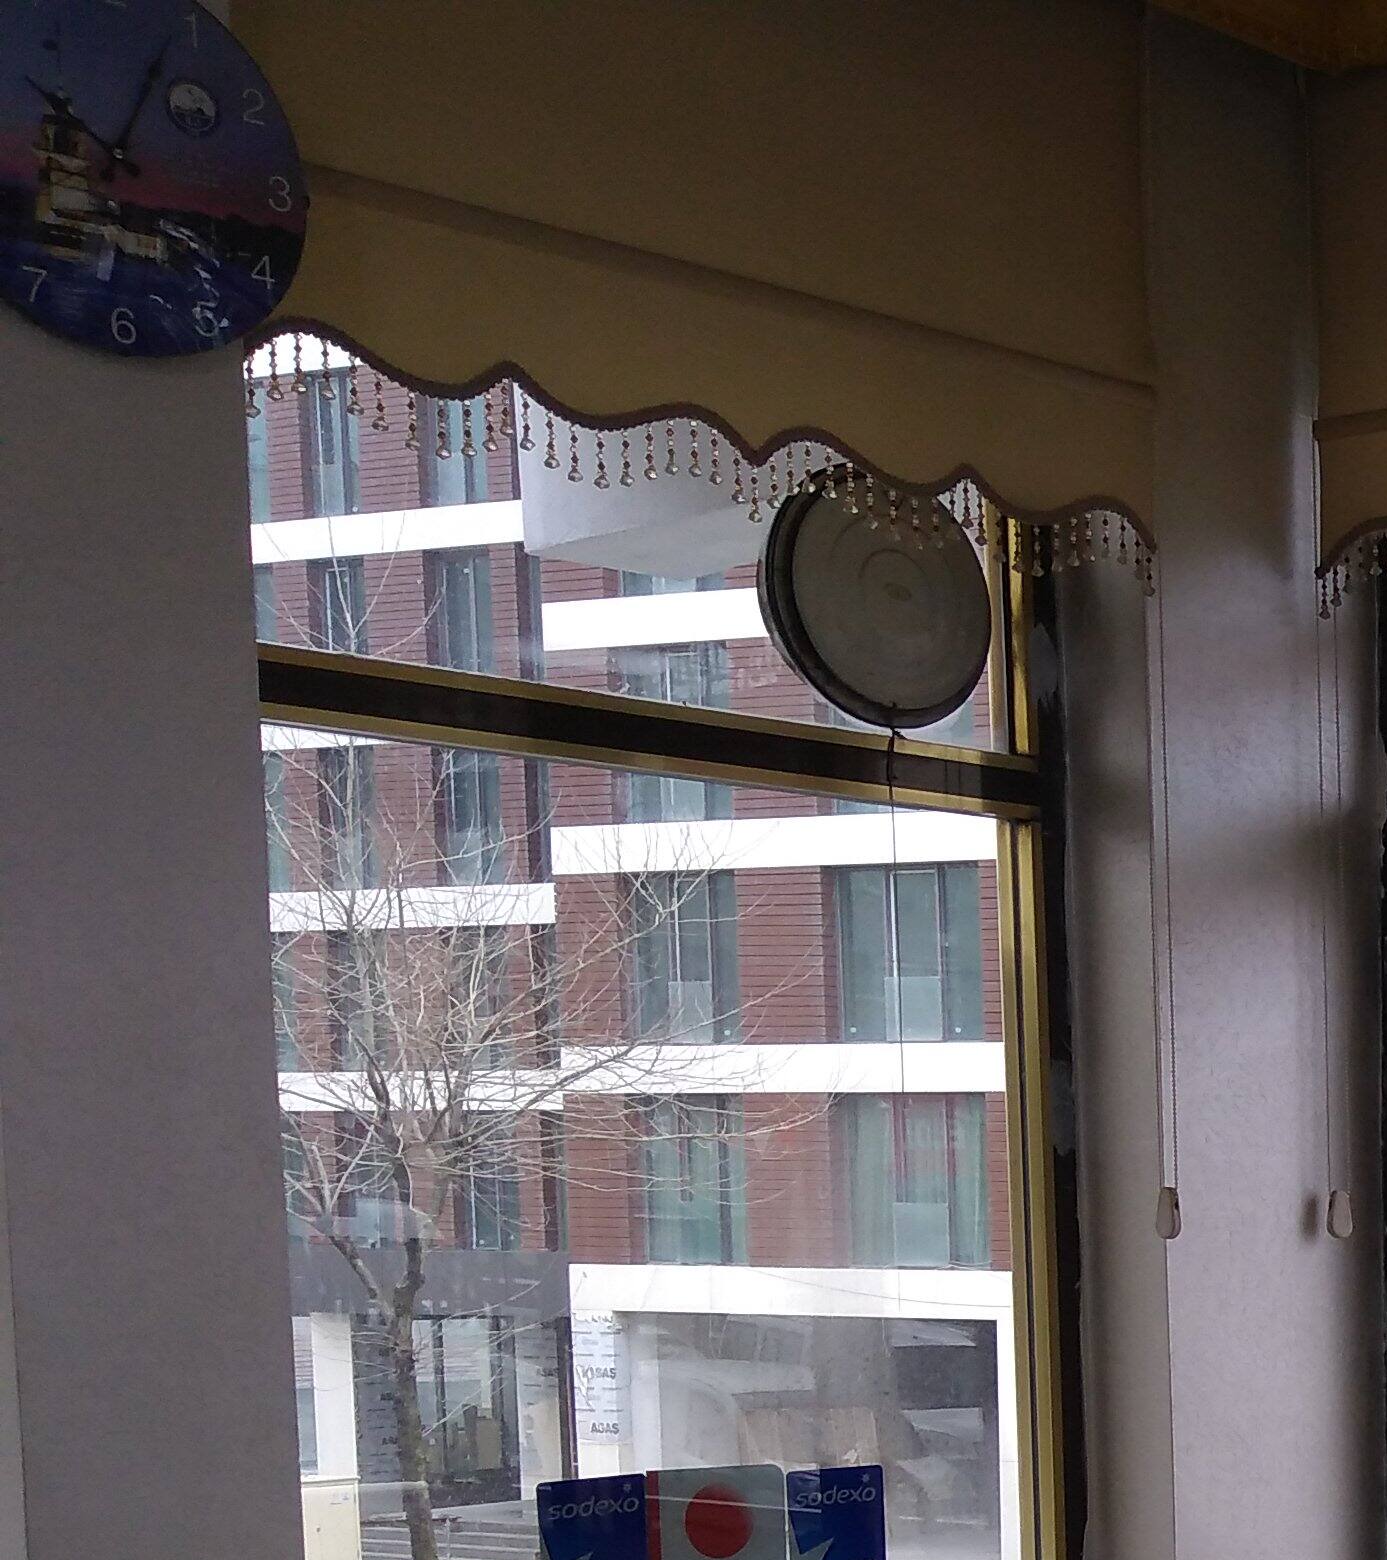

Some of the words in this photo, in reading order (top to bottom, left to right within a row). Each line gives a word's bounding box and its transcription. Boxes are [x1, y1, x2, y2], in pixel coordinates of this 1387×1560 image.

[242, 88, 266, 126] 2
[268, 175, 292, 212] 3
[21, 264, 48, 303] 7
[251, 254, 276, 290] 4
[110, 306, 137, 345] 6
[548, 1496, 640, 1520] sodexo
[795, 1485, 876, 1508] sodexo
